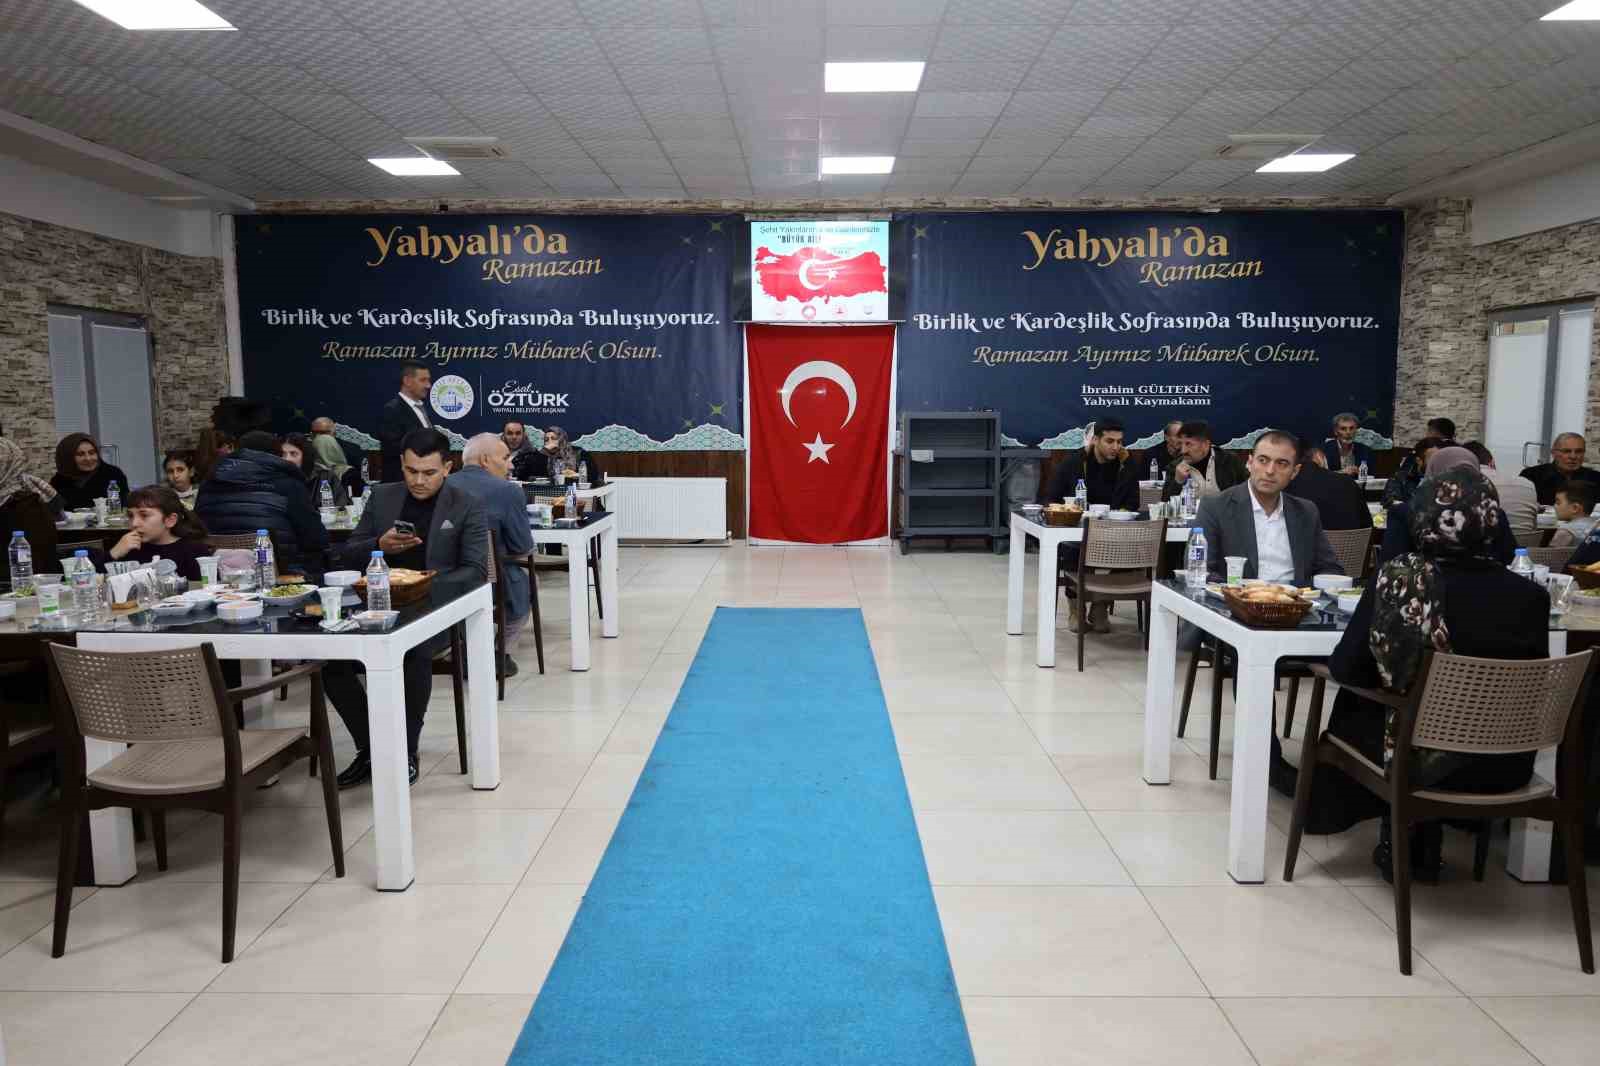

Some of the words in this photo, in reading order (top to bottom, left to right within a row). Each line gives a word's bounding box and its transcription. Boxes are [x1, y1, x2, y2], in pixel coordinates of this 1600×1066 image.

[481, 257, 604, 284] Ramazan
[1139, 259, 1264, 287] Ramazan
[261, 308, 329, 329] Birlik
[329, 312, 353, 327] ve
[357, 308, 464, 330] Kardeşlik
[464, 308, 574, 330] Sofrasında
[578, 308, 721, 330] Buluşuyoruz.
[912, 312, 981, 333] Birlik
[981, 316, 1005, 331] ve
[1010, 311, 1121, 333] Kardeşlik
[1118, 311, 1230, 333] Sofrasında
[1235, 311, 1380, 334] Buluşuyoruz.
[321, 341, 417, 362] Ramazan
[420, 340, 498, 366] Ayımız
[502, 340, 597, 364] Mübarek
[599, 340, 663, 360] Olsun.
[971, 345, 1069, 367] Ramazan
[1071, 345, 1151, 369] Ayımız
[1156, 342, 1252, 367] Mübarek
[1254, 342, 1320, 363] Olsun.
[487, 389, 570, 407] ÖZTÜRK
[1081, 383, 1134, 395] İbrahim
[1138, 384, 1210, 395] GÜLTEKİN
[1082, 396, 1130, 408] Yahyalı
[1134, 396, 1212, 408] Kaymakamı
